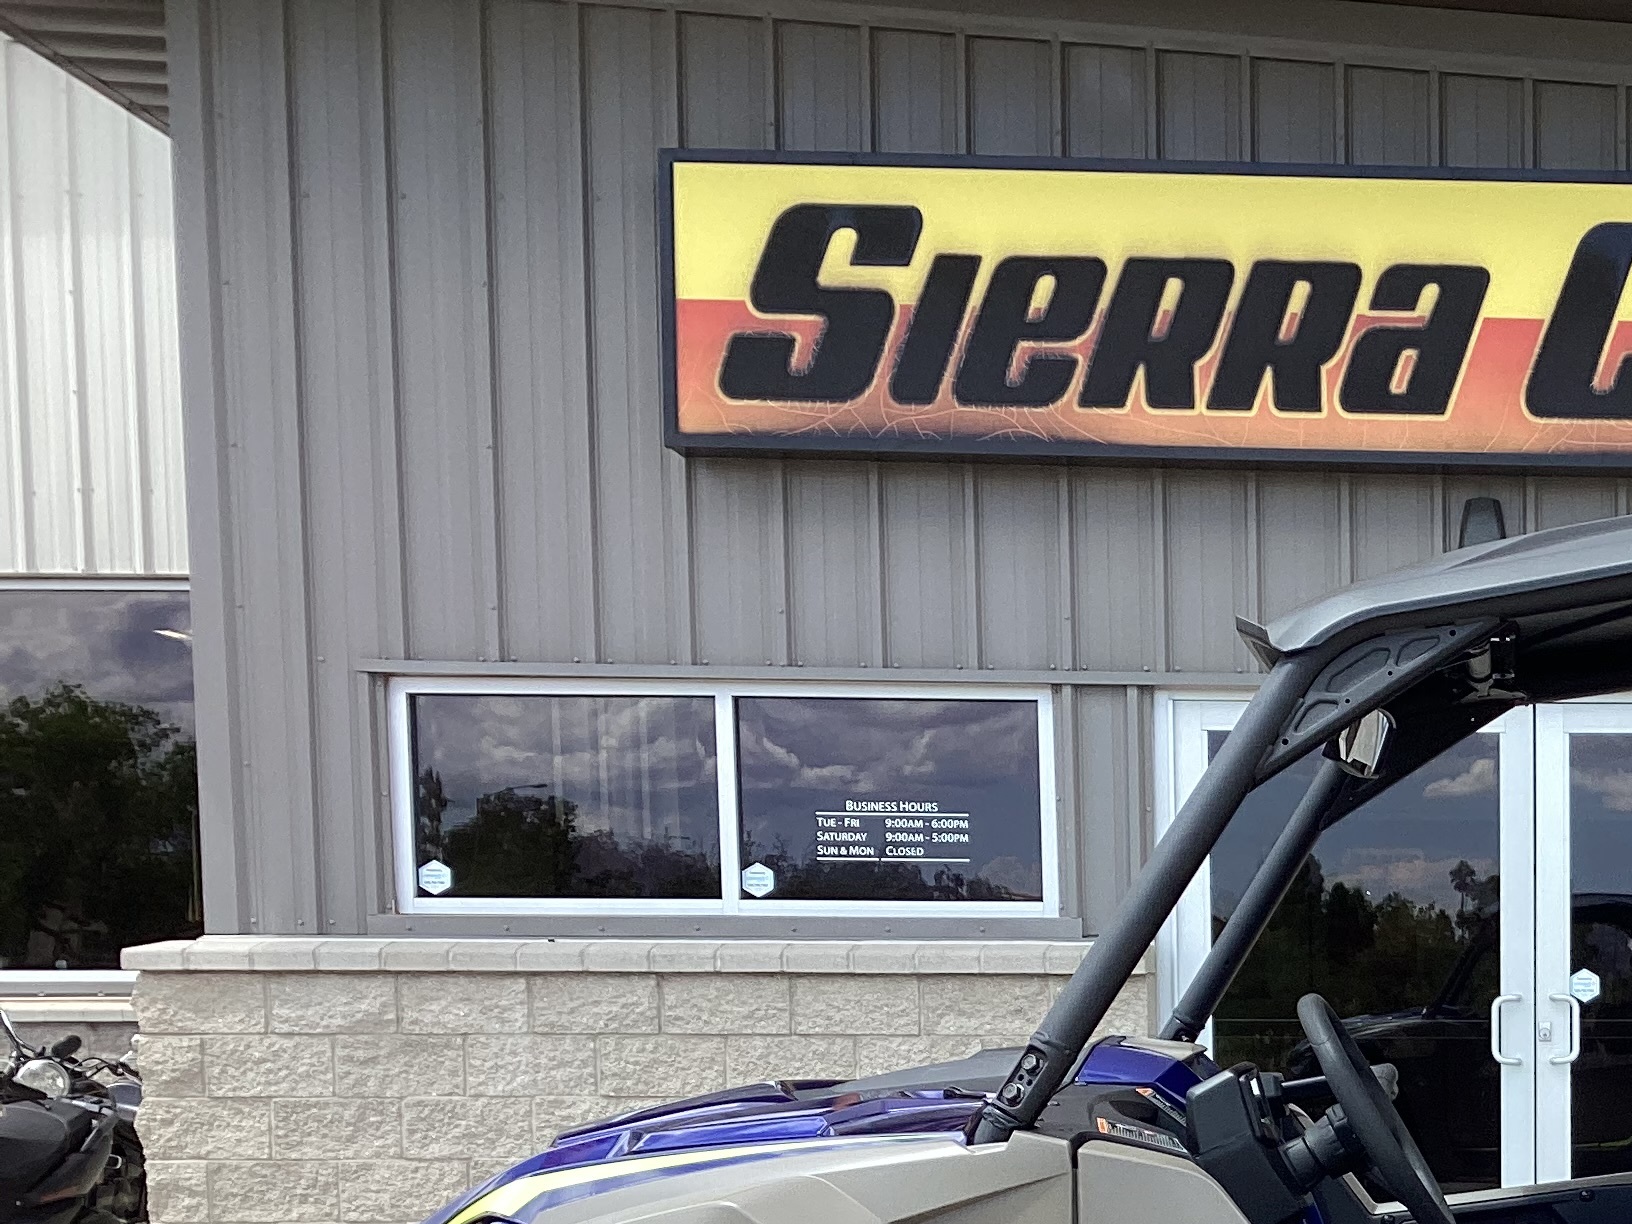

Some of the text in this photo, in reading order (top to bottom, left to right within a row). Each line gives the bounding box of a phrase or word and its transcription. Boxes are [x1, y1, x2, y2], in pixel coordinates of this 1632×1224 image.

[845, 800, 939, 813] BUSINESS HOURS
[816, 817, 837, 828] TUE
[844, 817, 860, 828] FRI
[884, 818, 924, 829] 9:00AM
[931, 818, 969, 829] 6:00PM
[816, 831, 868, 842] SATURDAY
[885, 832, 924, 843] 9:00AM
[931, 832, 969, 843] 5:00PM
[816, 845, 925, 856] SUN & MON CLOSED
